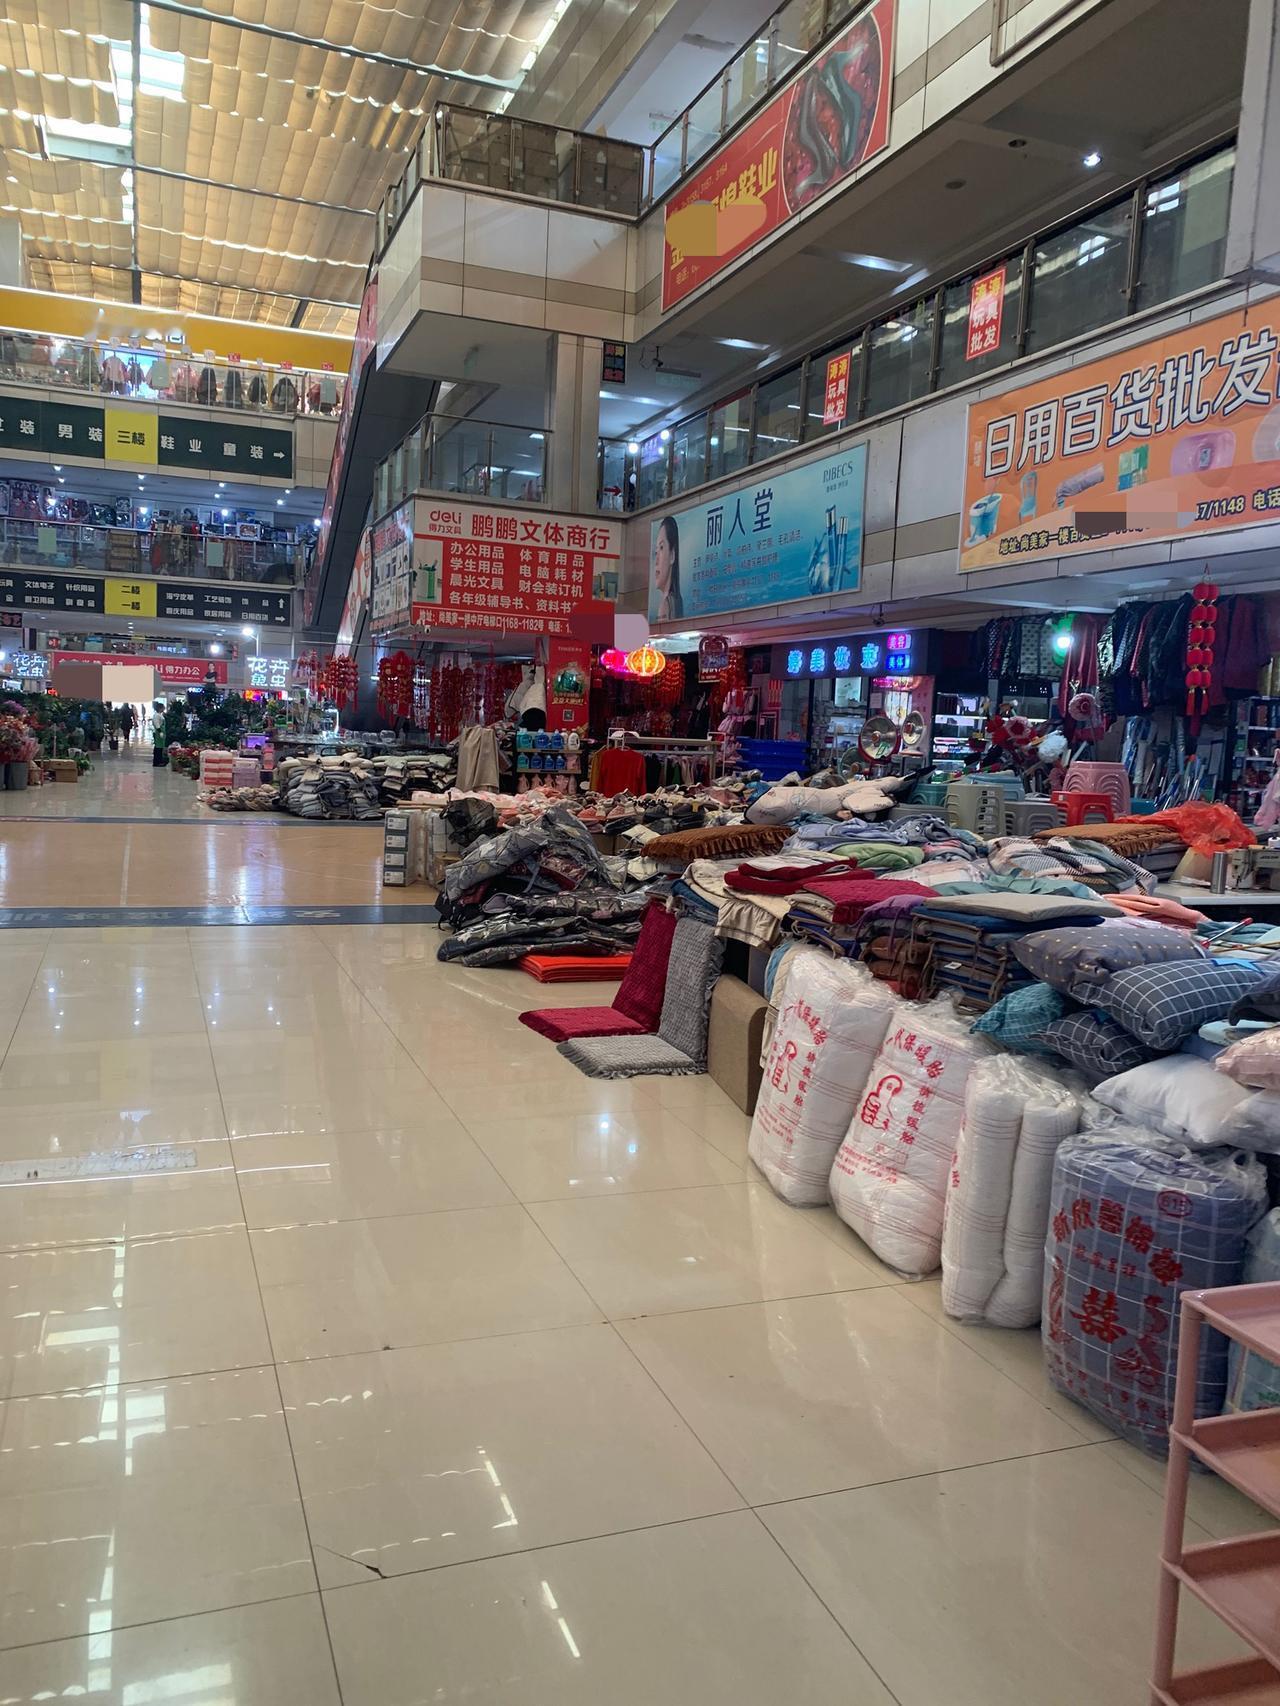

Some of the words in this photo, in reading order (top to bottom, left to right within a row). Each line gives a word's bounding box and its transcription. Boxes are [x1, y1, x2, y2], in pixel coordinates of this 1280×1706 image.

[970, 326, 996, 353] 批发
[985, 328, 1280, 477] 日用百货批发
[58, 423, 103, 442] 男装
[117, 430, 146, 446] 三楼
[160, 435, 202, 452] 鞋业
[223, 442, 263, 459] 童装
[430, 510, 462, 525] deli
[707, 488, 773, 548] 丽人堂
[1195, 492, 1244, 521] 7/1148
[429, 523, 462, 535] 得力文具
[472, 514, 610, 550] 鹏鹏文体商行
[450, 541, 505, 559] 办公用品
[520, 548, 585, 568] 体育用品
[450, 557, 504, 575] 学生用品
[519, 564, 585, 583] 电脑耗材
[121, 585, 140, 595] 二楼
[449, 573, 504, 590] 晨光文具
[518, 580, 584, 598] 财会装订机
[121, 601, 140, 611] 一楼
[449, 590, 578, 614] 各年级辅导书、资料书
[165, 665, 200, 676] 得力办公
[247, 656, 290, 675] 花卉
